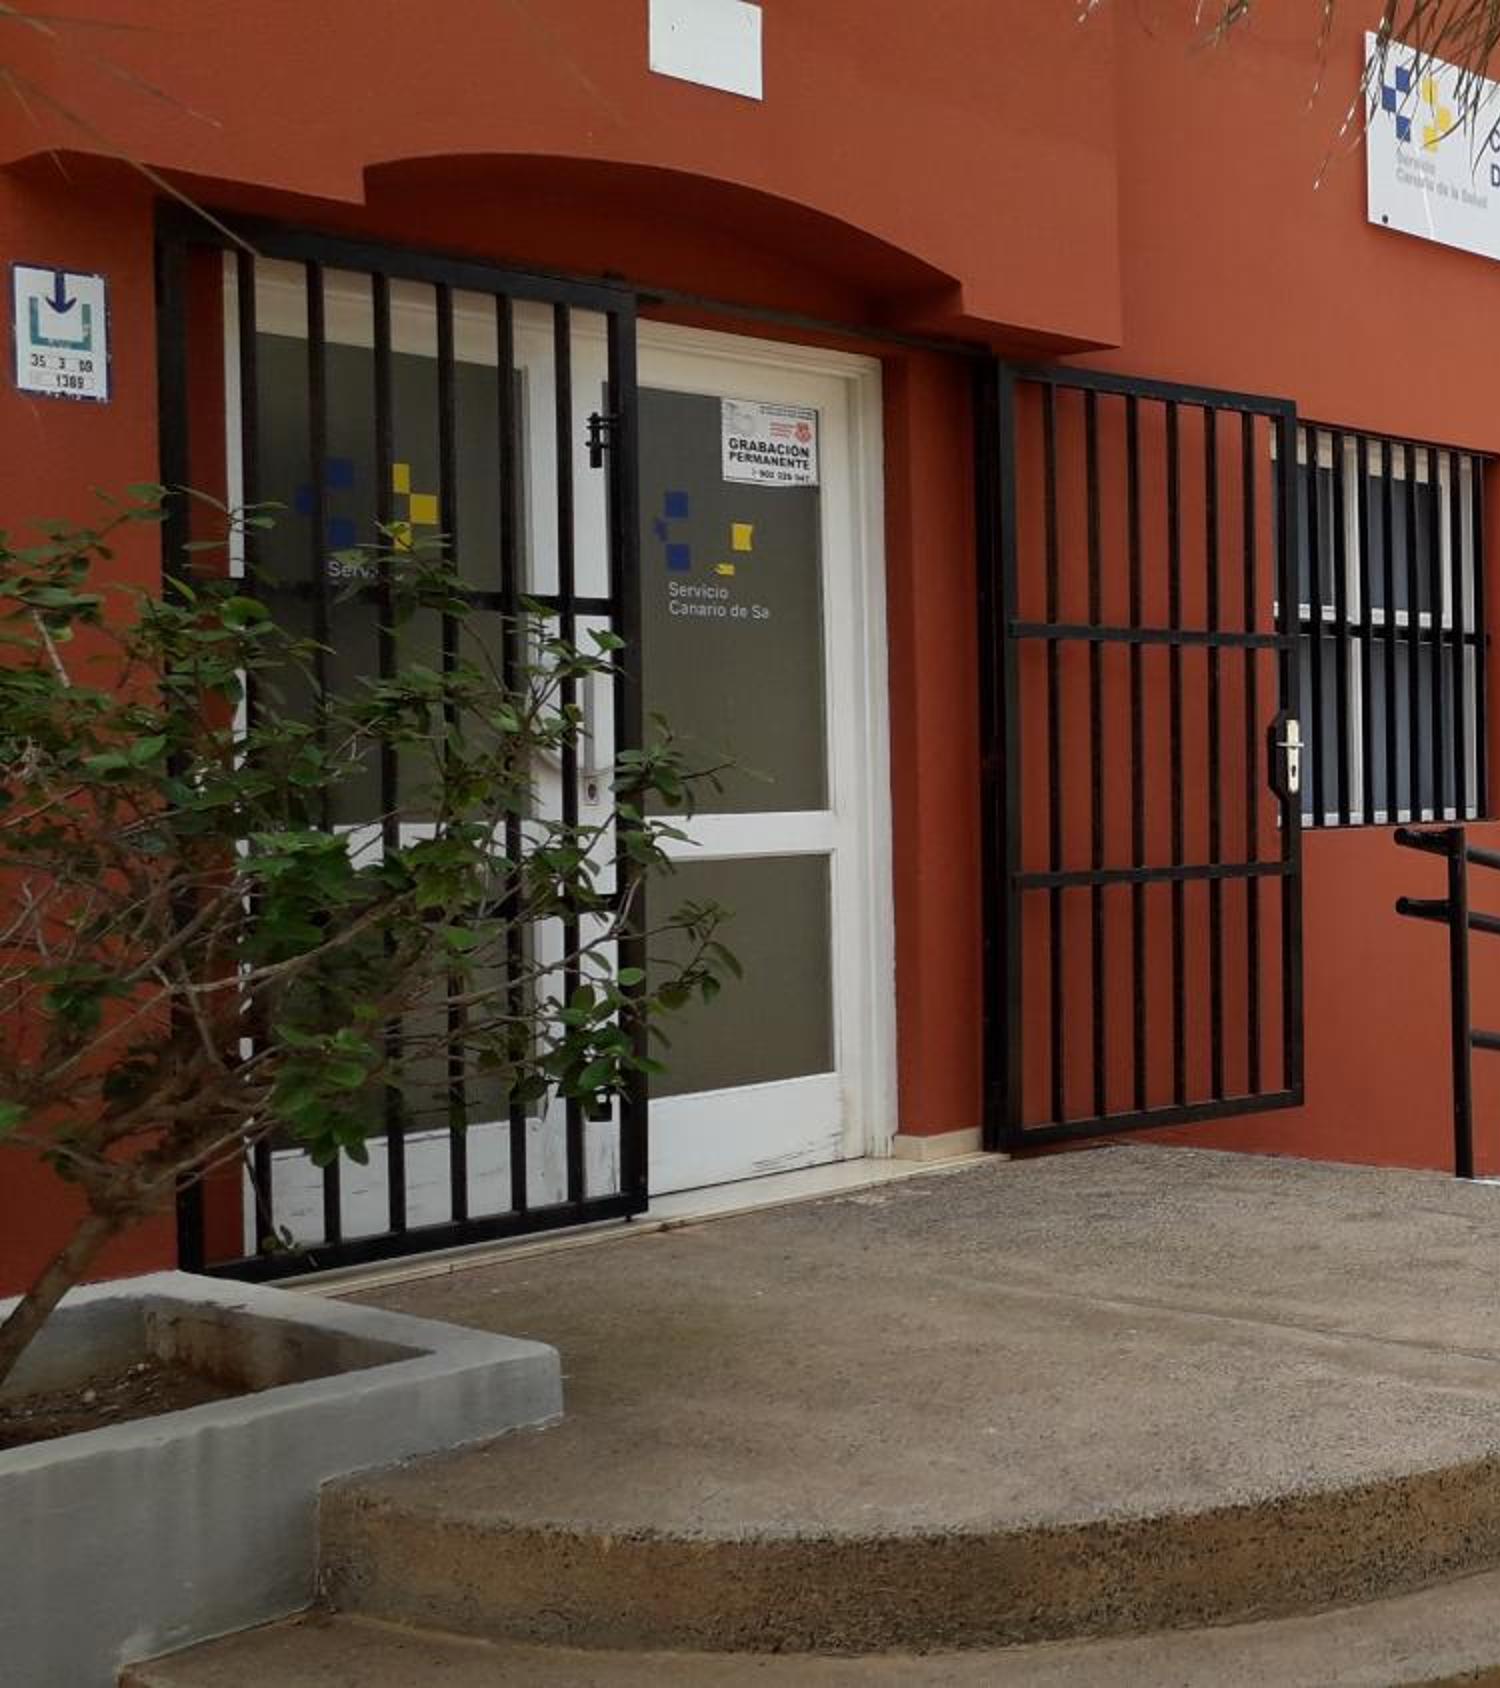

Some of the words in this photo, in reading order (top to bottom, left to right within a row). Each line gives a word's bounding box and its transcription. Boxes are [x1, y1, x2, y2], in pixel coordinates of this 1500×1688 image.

[729, 451, 810, 470] PERMANENTE
[669, 581, 729, 599] Servicio
[669, 600, 726, 617] Canario
[730, 604, 748, 618] de
[751, 605, 769, 619] Sa
